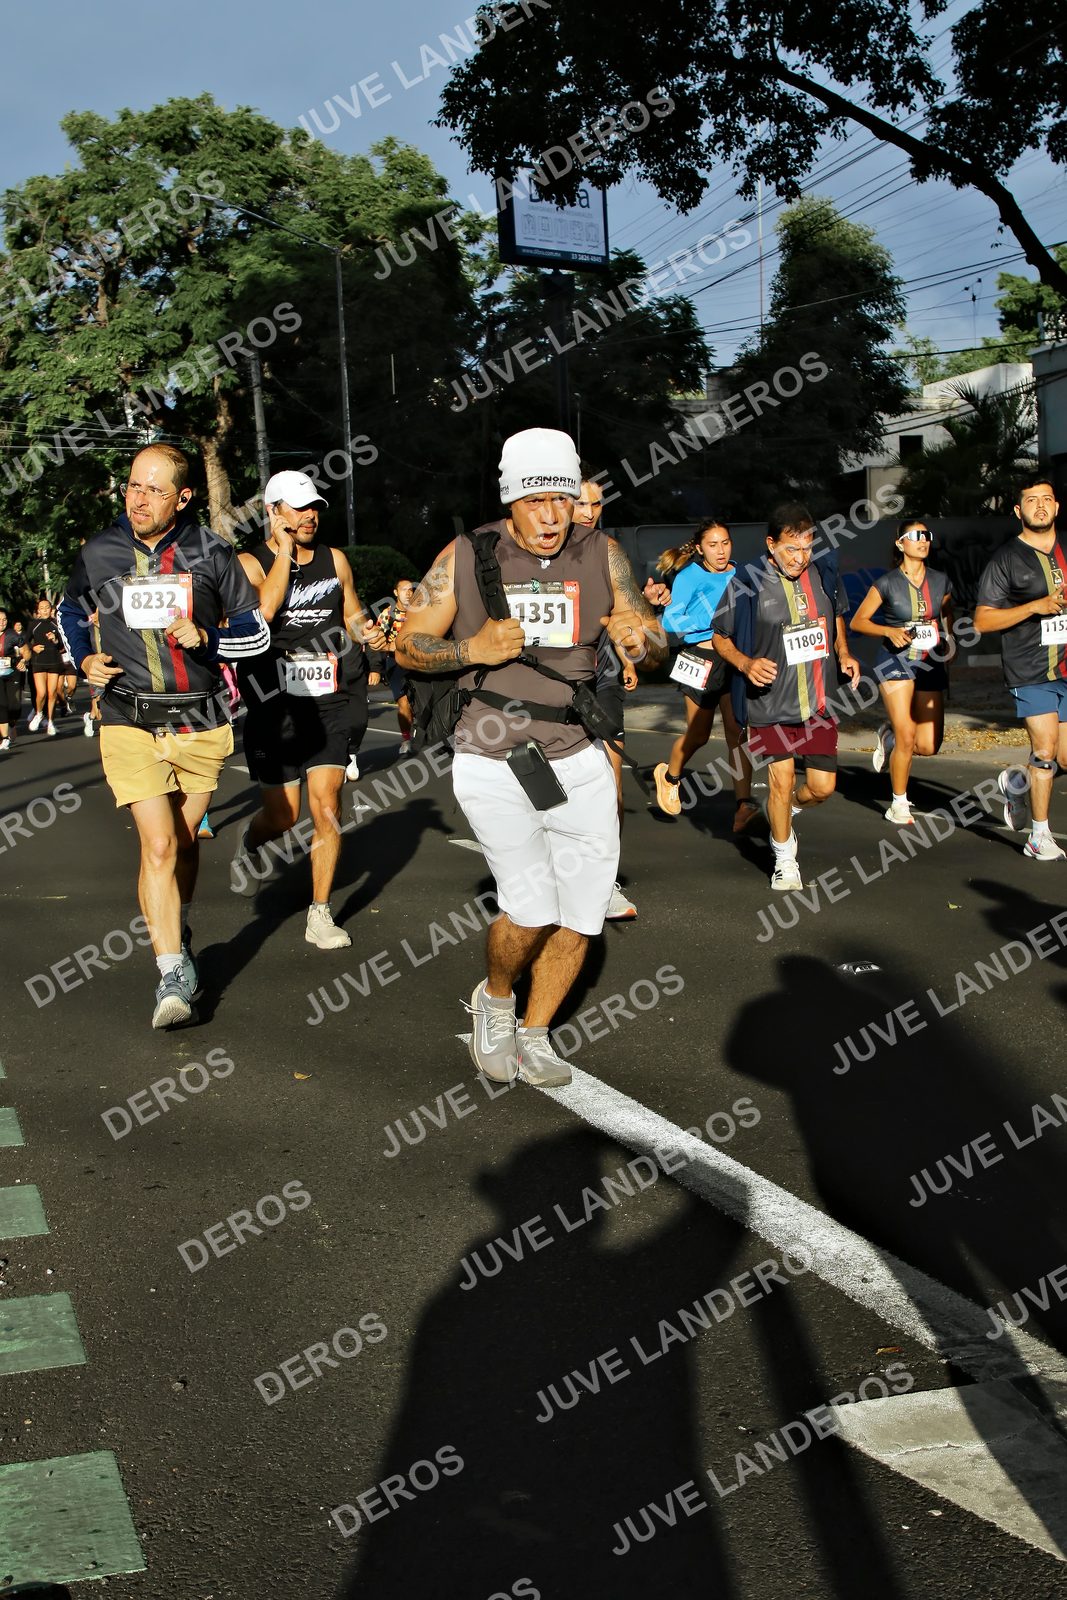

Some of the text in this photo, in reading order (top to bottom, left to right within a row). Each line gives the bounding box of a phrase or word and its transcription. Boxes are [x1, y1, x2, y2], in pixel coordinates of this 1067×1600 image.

[543, 476, 576, 484] NORTH
[131, 591, 176, 609] 8232
[282, 609, 333, 617] NIKE
[787, 632, 823, 651] 11809
[290, 666, 331, 681] 10036
[678, 660, 699, 677] 8711
